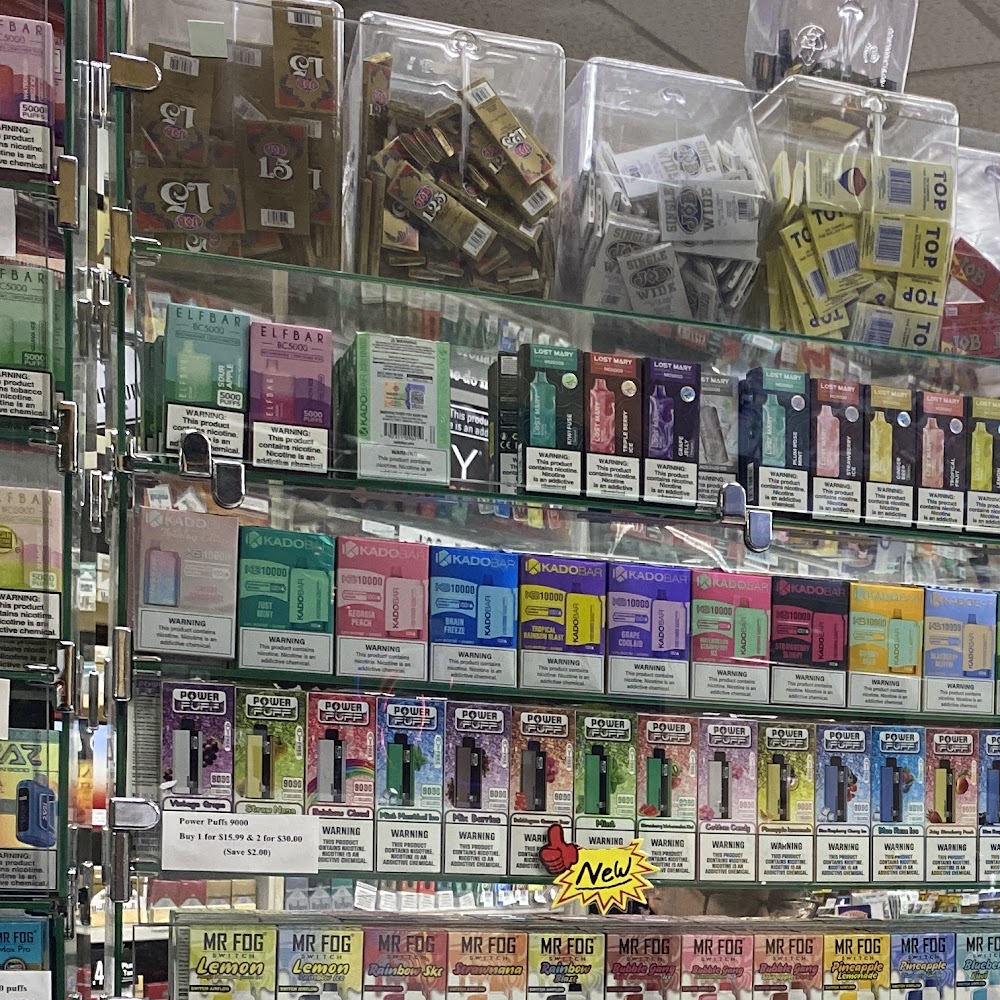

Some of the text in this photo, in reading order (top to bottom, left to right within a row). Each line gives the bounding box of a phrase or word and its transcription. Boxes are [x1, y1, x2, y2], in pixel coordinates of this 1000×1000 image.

[933, 170, 948, 211] TOP
[923, 226, 940, 268] TOP
[626, 250, 668, 271] SINGLE
[631, 266, 672, 285] JOB
[636, 282, 677, 300] WIDE
[261, 326, 324, 344] ELFBAR
[277, 342, 308, 352] BC5000
[348, 610, 376, 620] GEORGIA
[351, 619, 372, 628] PEACH
[180, 690, 220, 701] POWER
[208, 818, 228, 826] Puffs
[180, 833, 195, 841] Buy
[256, 834, 261, 842] 2
[247, 849, 271, 857] $2.00)
[576, 857, 632, 885] New
[204, 933, 264, 951] MR FOG
[196, 957, 264, 976] Lemon
[7, 985, 28, 993] puffs
